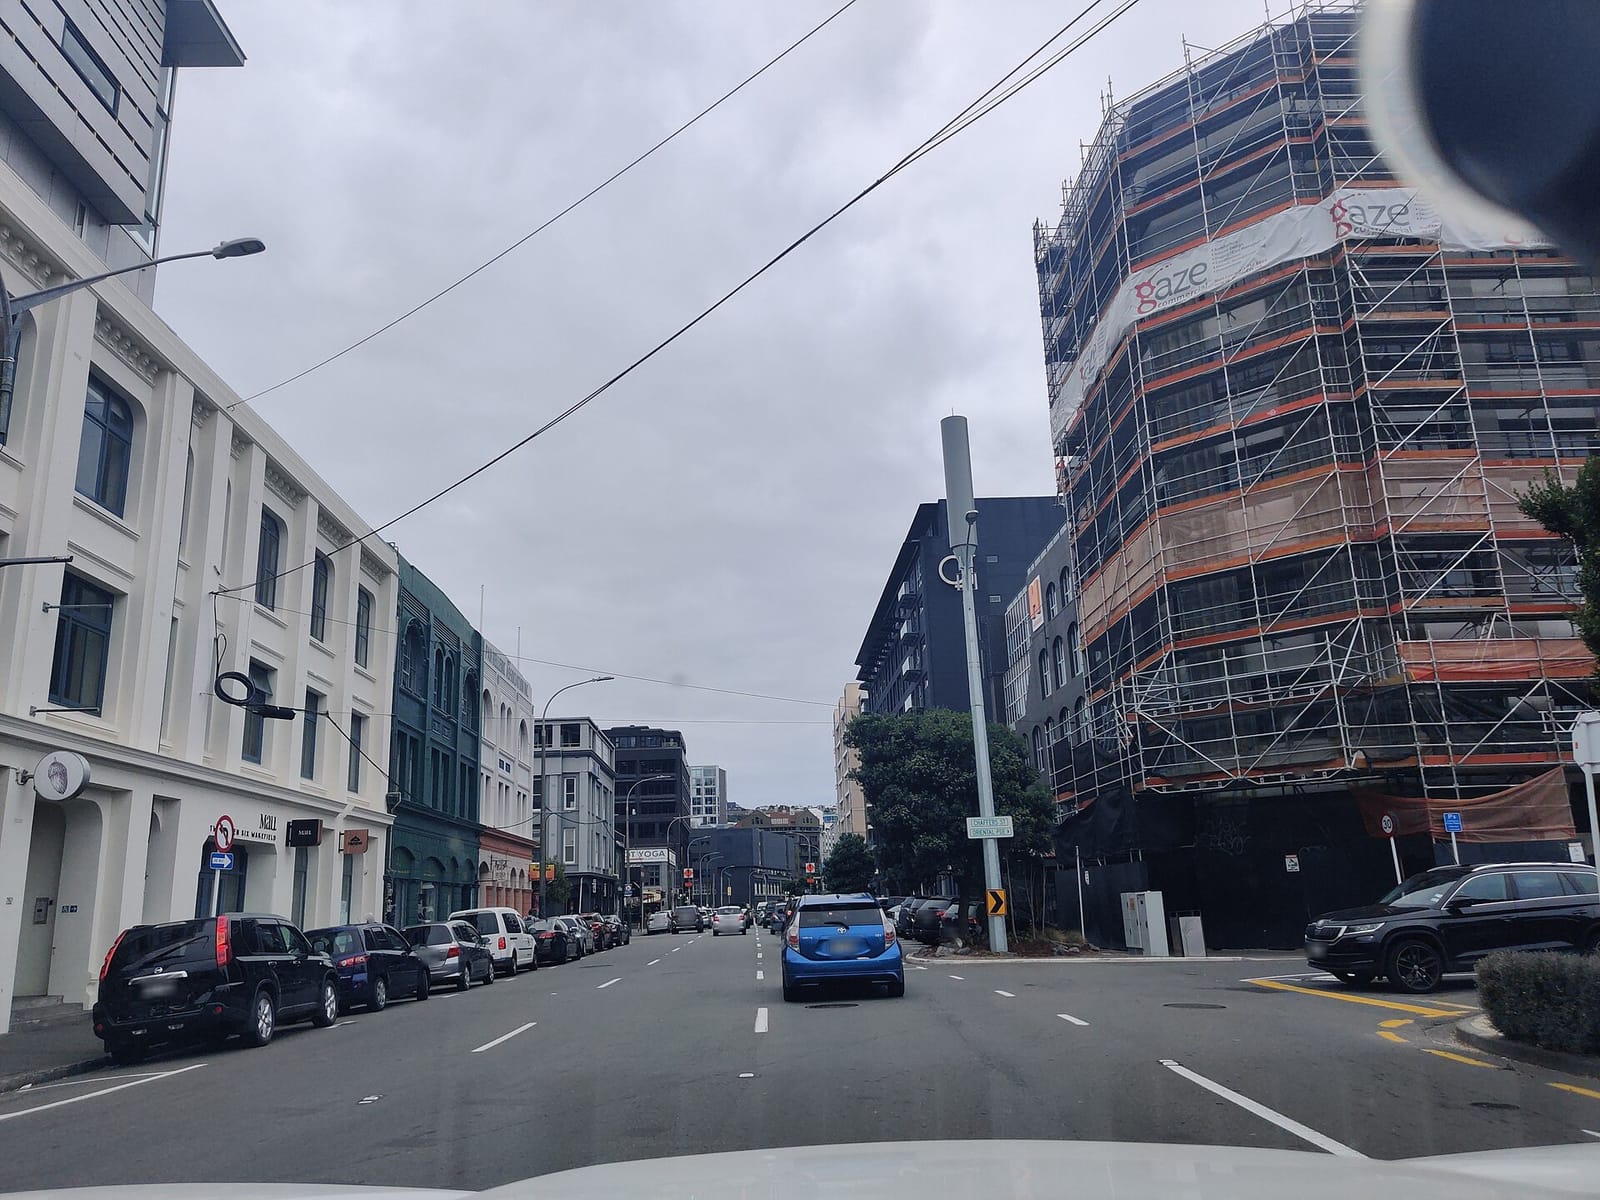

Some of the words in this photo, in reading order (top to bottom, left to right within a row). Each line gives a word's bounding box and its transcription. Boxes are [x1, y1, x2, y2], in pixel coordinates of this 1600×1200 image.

[1330, 197, 1410, 239] gaze
[1135, 262, 1207, 315] gaze
[251, 830, 276, 841] WAKEFIELD
[1383, 818, 1391, 829] 30
